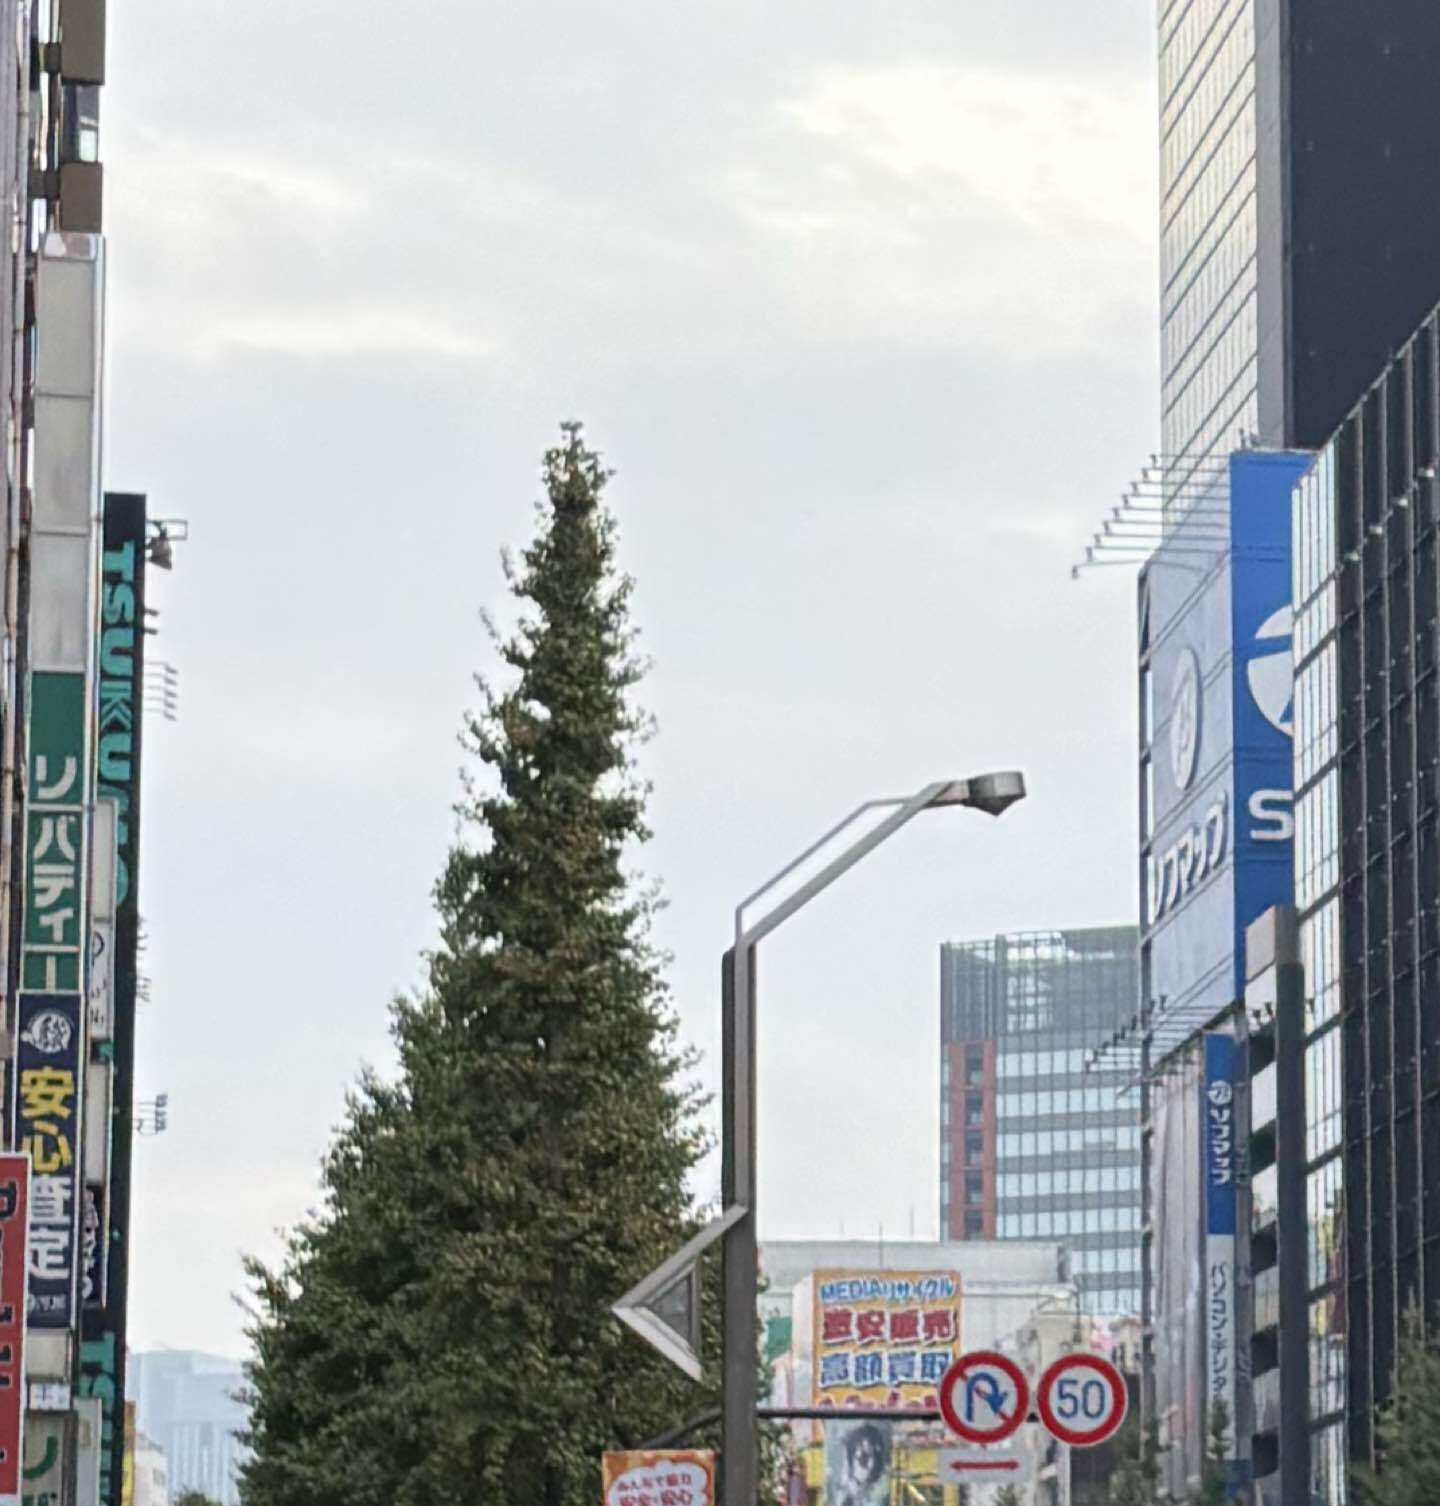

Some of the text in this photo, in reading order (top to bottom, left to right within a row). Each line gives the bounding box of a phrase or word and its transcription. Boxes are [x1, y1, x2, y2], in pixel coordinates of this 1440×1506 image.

[33, 753, 79, 992] リバティー
[1056, 1379, 1106, 1420] 50
